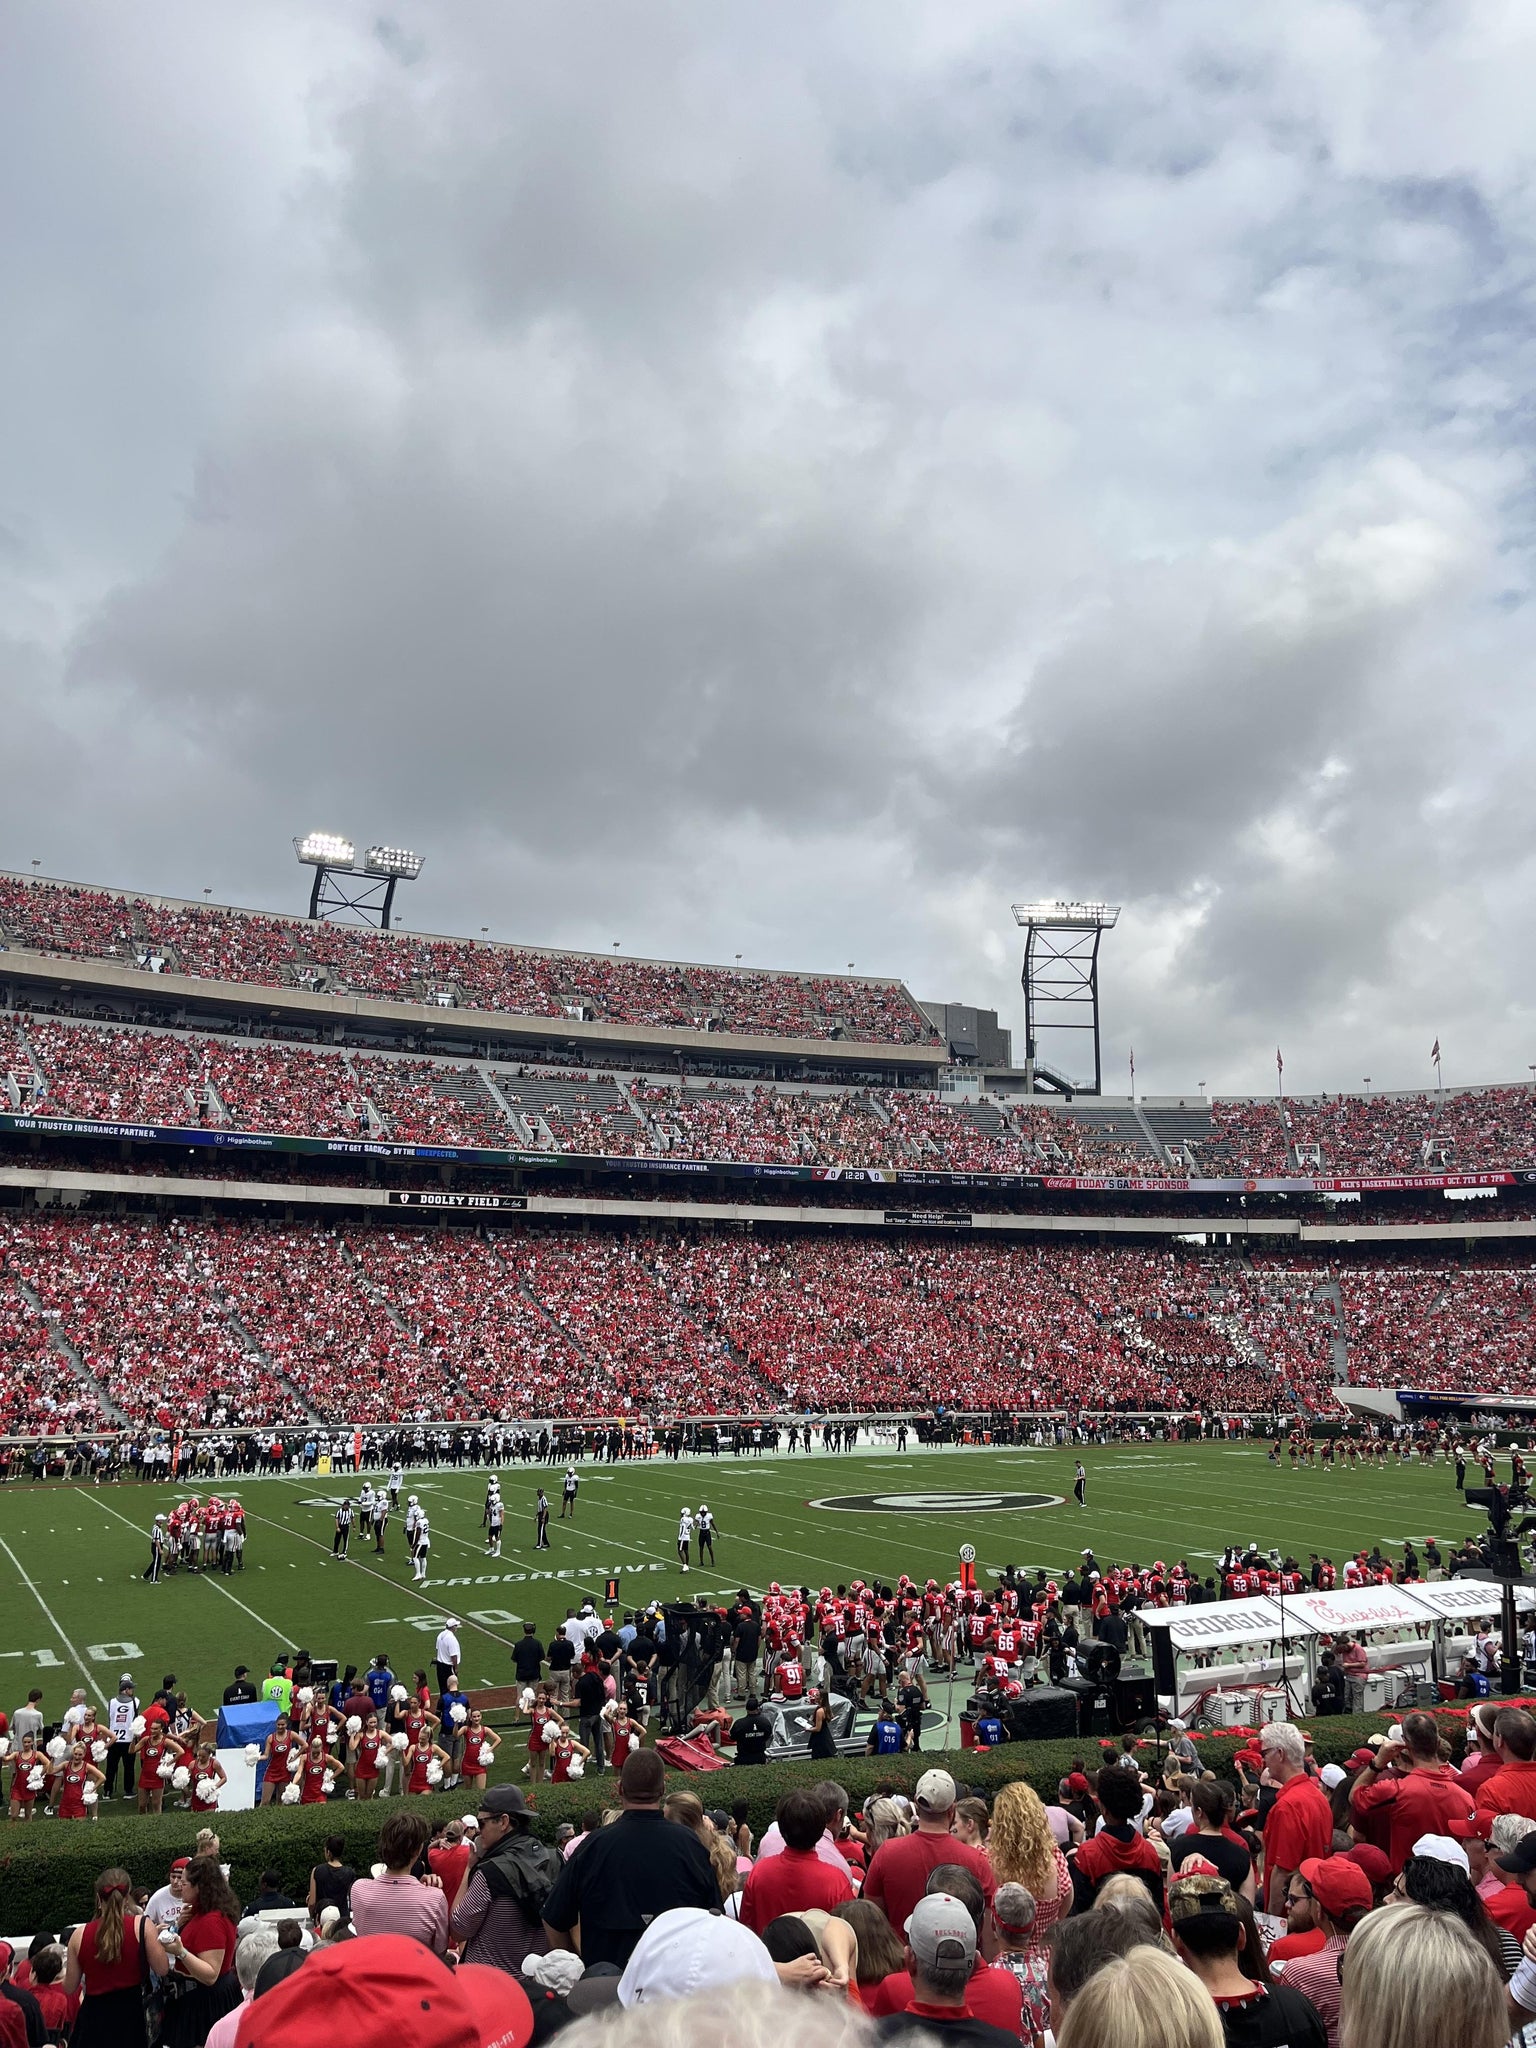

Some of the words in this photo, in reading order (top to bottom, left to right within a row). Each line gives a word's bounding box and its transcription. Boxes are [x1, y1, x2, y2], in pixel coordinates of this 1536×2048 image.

[14, 1119, 36, 1128] YOUR
[38, 1121, 73, 1131] TRUSTED
[74, 1124, 118, 1135] INSURANCE
[119, 1128, 157, 1138] PARTNER.
[227, 1136, 273, 1146] Higginbotham
[328, 1143, 348, 1152] DON'T
[349, 1144, 362, 1152] GET
[364, 1144, 392, 1156] SACKED
[393, 1147, 402, 1155] BY
[518, 1155, 557, 1164] Higginbotham
[622, 1161, 648, 1169] TRUSTED
[649, 1162, 681, 1170] INSURANCE
[763, 1168, 799, 1176] Higginbotham
[1076, 1180, 1115, 1189] TODAY'S
[1116, 1180, 1144, 1189] GAME
[1146, 1180, 1190, 1190] SPONSOR
[1340, 1180, 1360, 1189] MEN'S
[1361, 1179, 1403, 1188] BASKETBALL
[1405, 1179, 1413, 1187] VS
[1414, 1178, 1423, 1186] GA
[1424, 1178, 1444, 1186] STATE
[1447, 1177, 1461, 1185] OCT.
[1462, 1176, 1476, 1184] 7TH
[1479, 1175, 1488, 1183] AT
[1490, 1174, 1505, 1182] 7PM
[420, 1194, 465, 1205] DOOLEY
[468, 1196, 500, 1207] FIELD
[419, 1562, 668, 1589] PROGRESSIVE
[1173, 1584, 1186, 1596] 20
[1233, 1580, 1247, 1592] 52
[1429, 1586, 1524, 1609] GEORG
[403, 1608, 524, 1633] 20
[1165, 1610, 1280, 1637] GEORGIA
[972, 1621, 984, 1636] 79
[1020, 1626, 1035, 1642] 65
[998, 1635, 1014, 1651] 66
[30, 1642, 145, 1667] 10
[786, 1668, 801, 1685] 91
[994, 1661, 1008, 1677] 99
[117, 1705, 129, 1713] G
